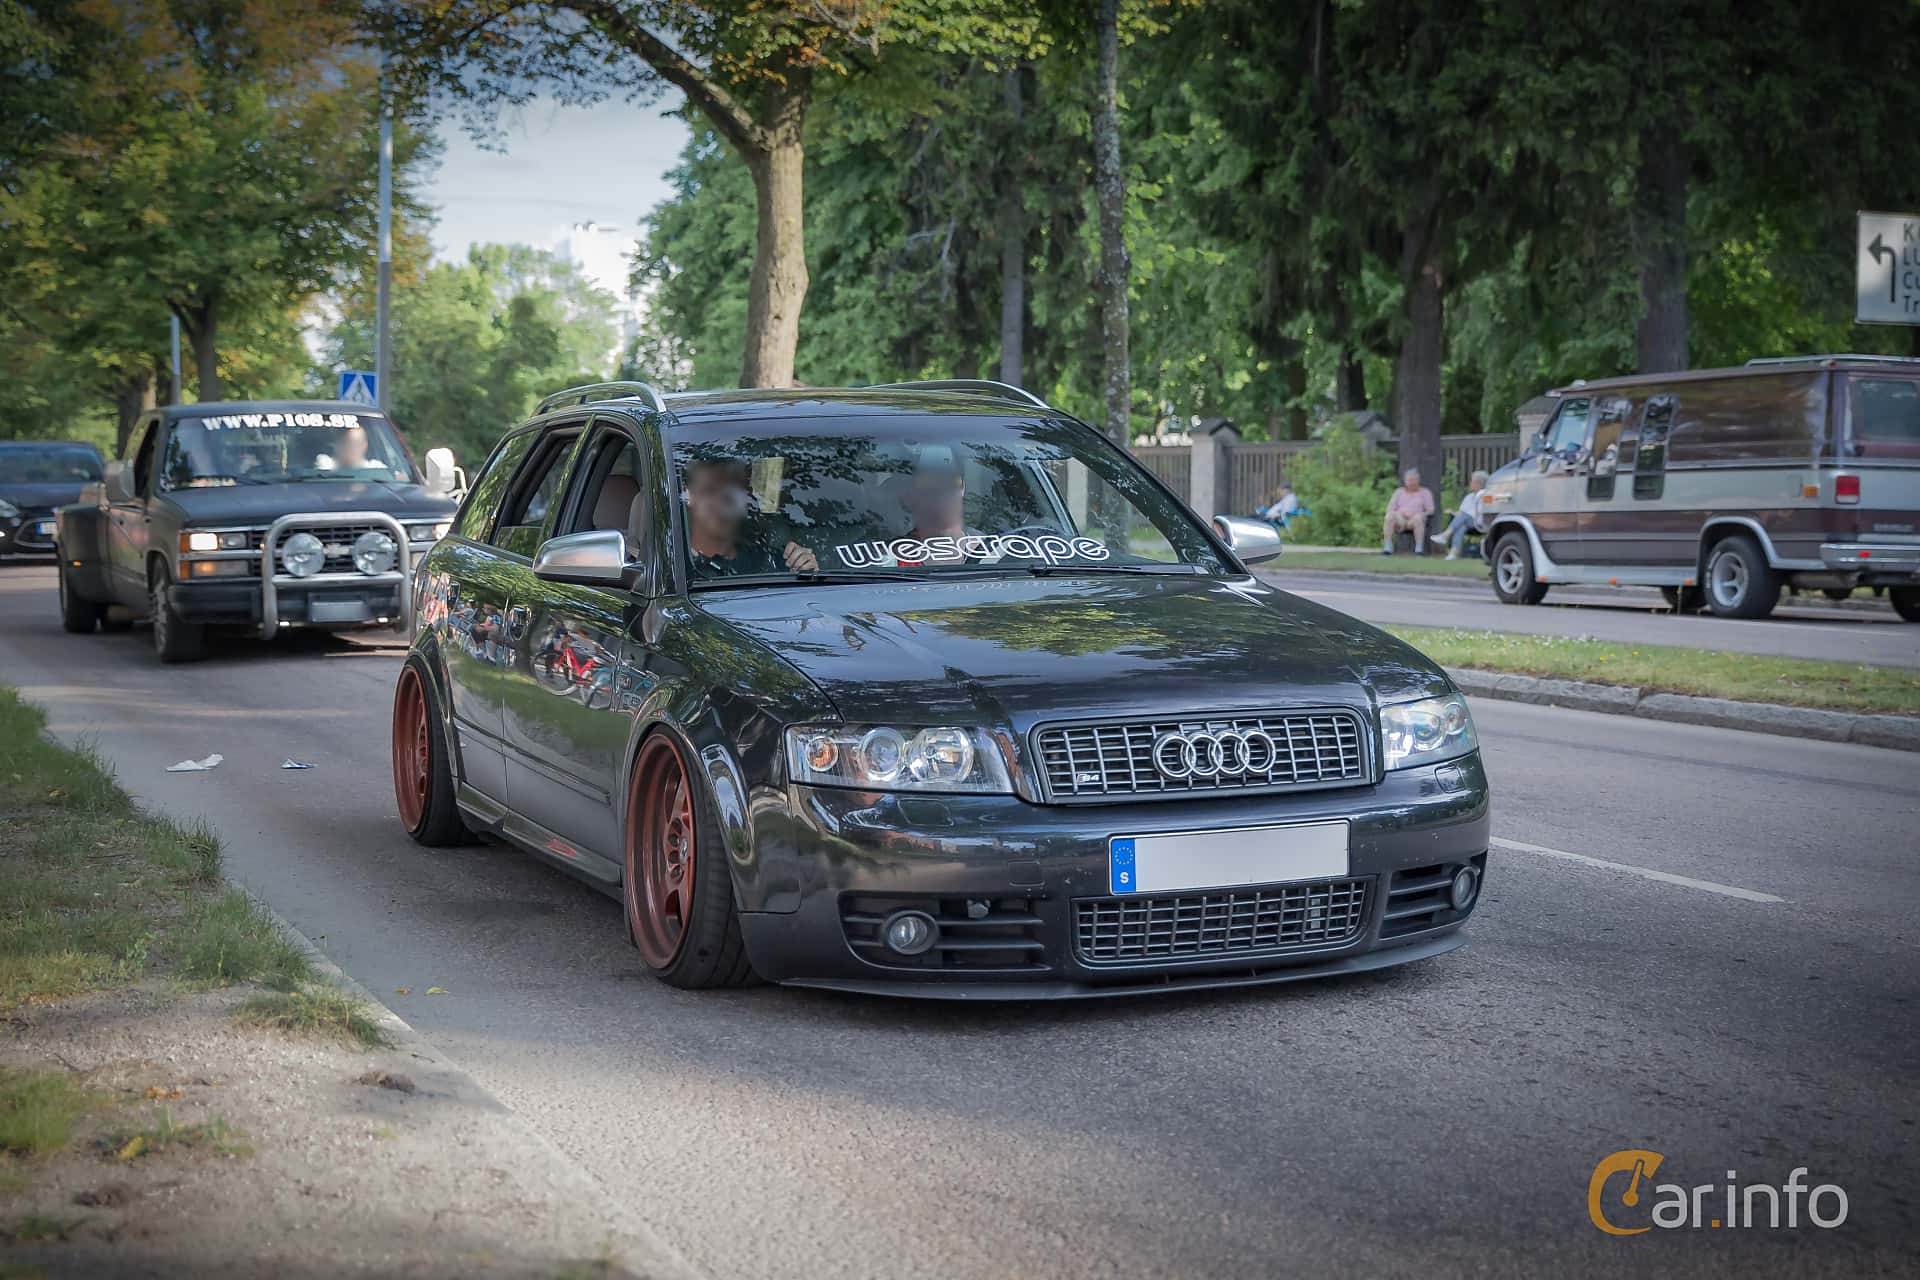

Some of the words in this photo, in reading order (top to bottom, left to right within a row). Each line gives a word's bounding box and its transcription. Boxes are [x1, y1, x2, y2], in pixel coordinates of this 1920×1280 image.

[1903, 223, 1920, 241] K
[835, 535, 1110, 567] wescrape
[1119, 871, 1129, 884] S
